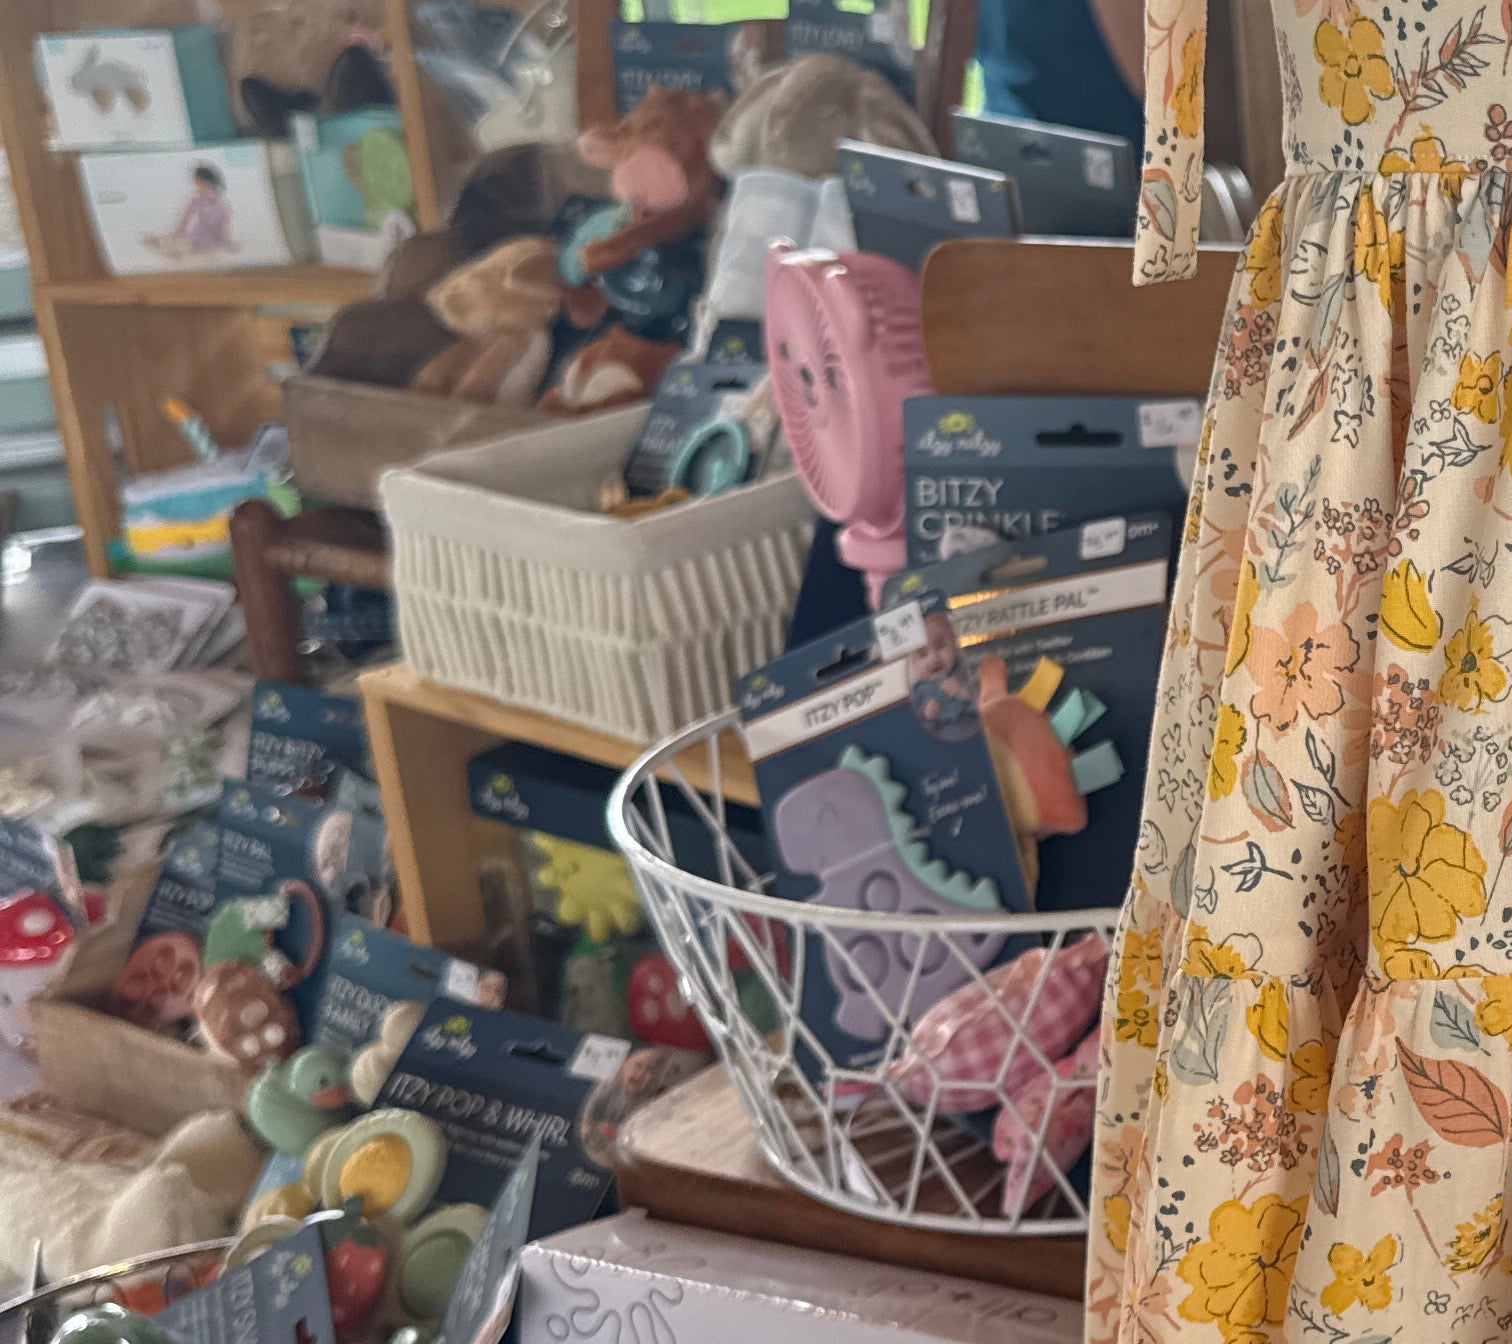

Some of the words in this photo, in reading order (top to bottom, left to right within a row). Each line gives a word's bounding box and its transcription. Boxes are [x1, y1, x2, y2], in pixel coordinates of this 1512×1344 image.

[916, 476, 1004, 507] BITZY
[804, 697, 843, 728] ITZY
[843, 684, 875, 709] POP
[430, 1084, 487, 1121] POP
